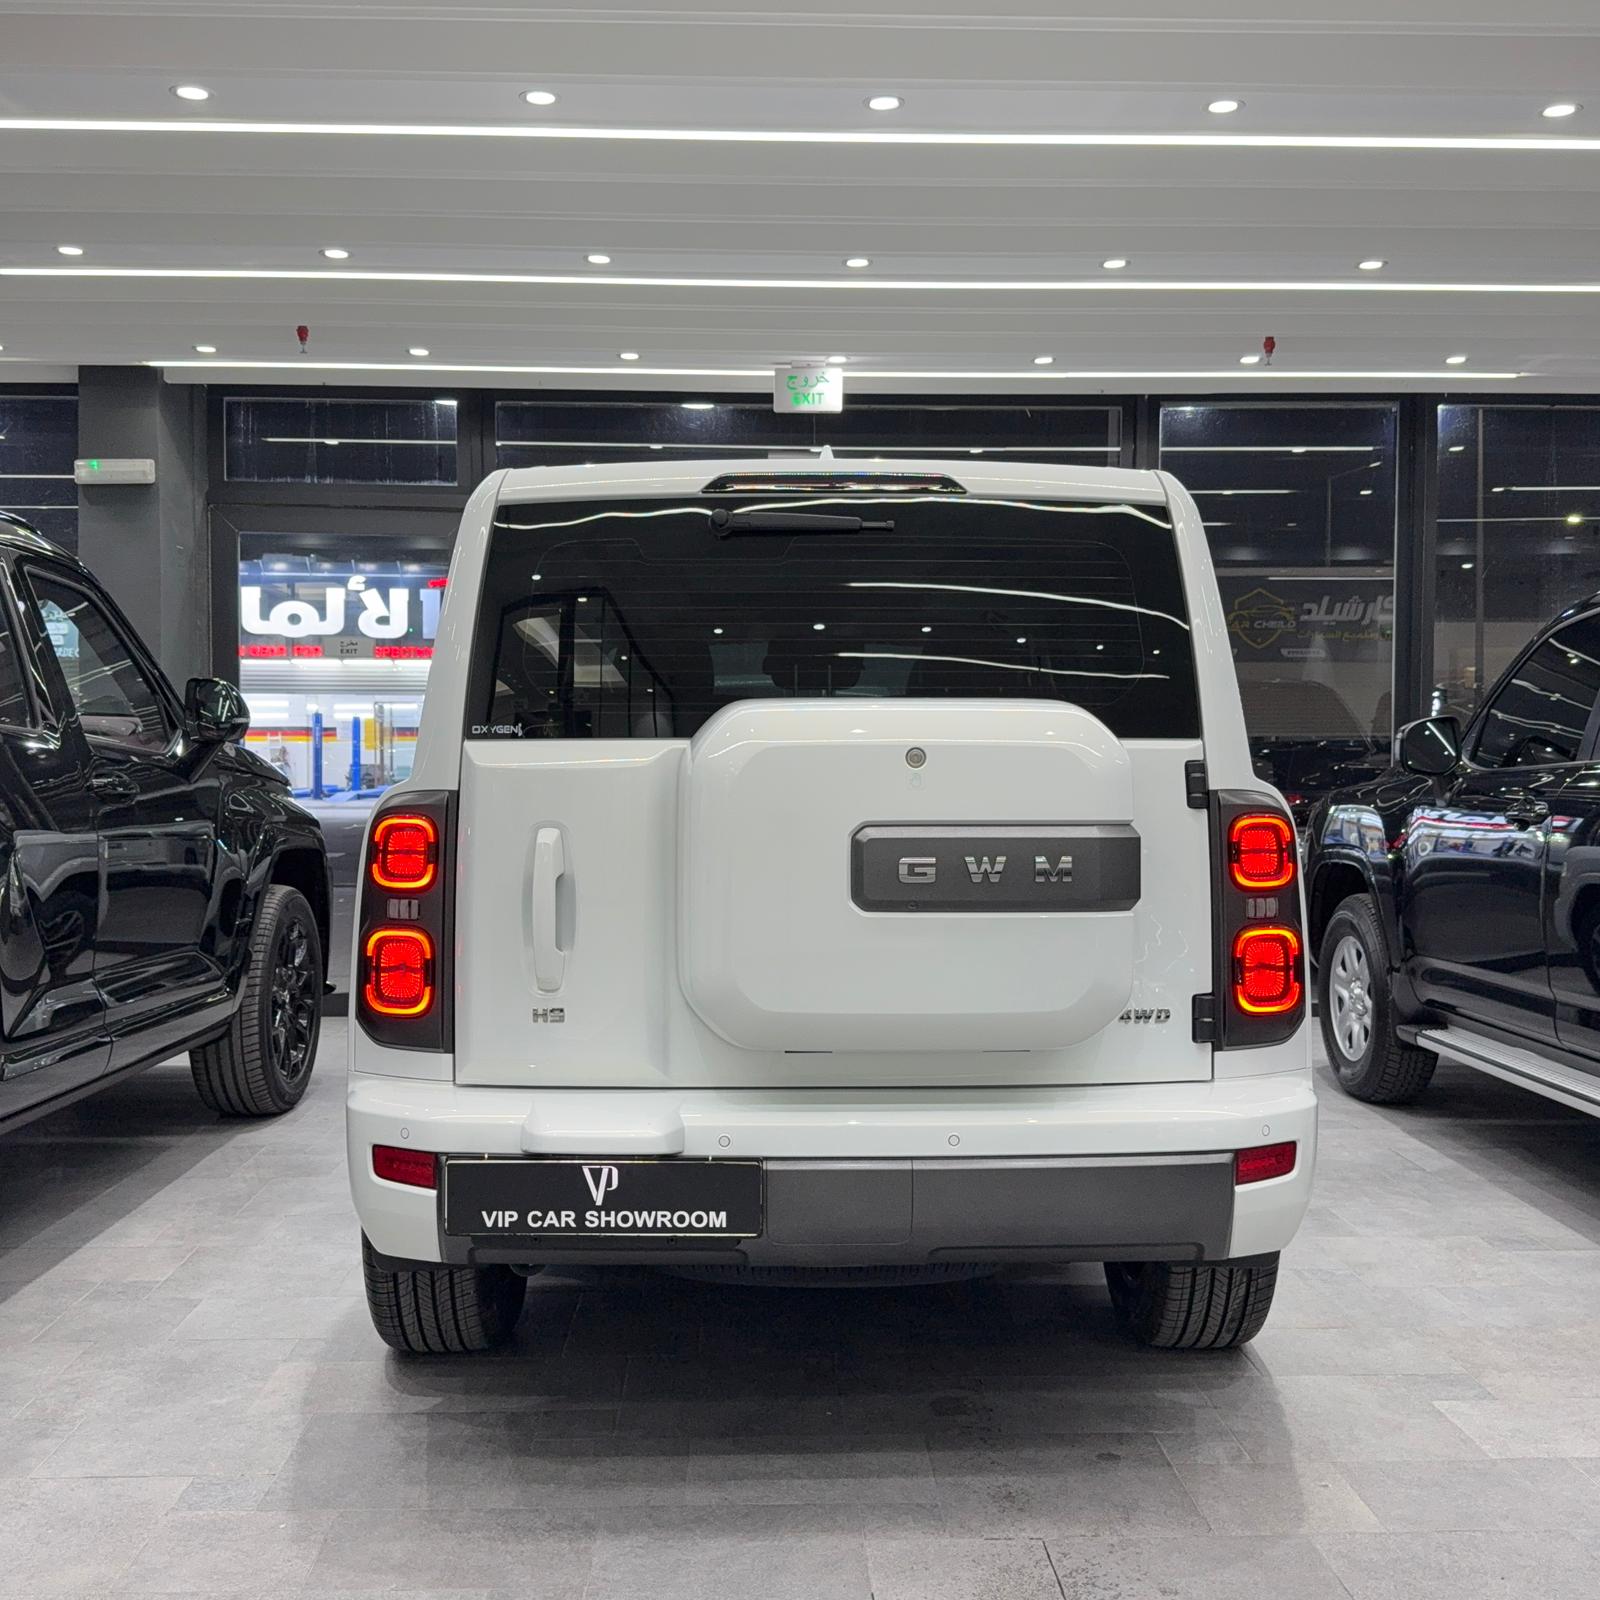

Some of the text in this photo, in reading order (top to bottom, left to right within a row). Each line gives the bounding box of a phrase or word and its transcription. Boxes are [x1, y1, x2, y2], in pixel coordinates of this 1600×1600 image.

[786, 371, 830, 390] خروج
[791, 392, 825, 405] EXIT
[472, 725, 519, 734] OXYGEN
[898, 856, 1073, 883] GWM
[532, 1007, 565, 1023] H9
[1118, 1008, 1171, 1024] 4WD
[481, 1210, 727, 1228] VIP CAR SHOWROOM
